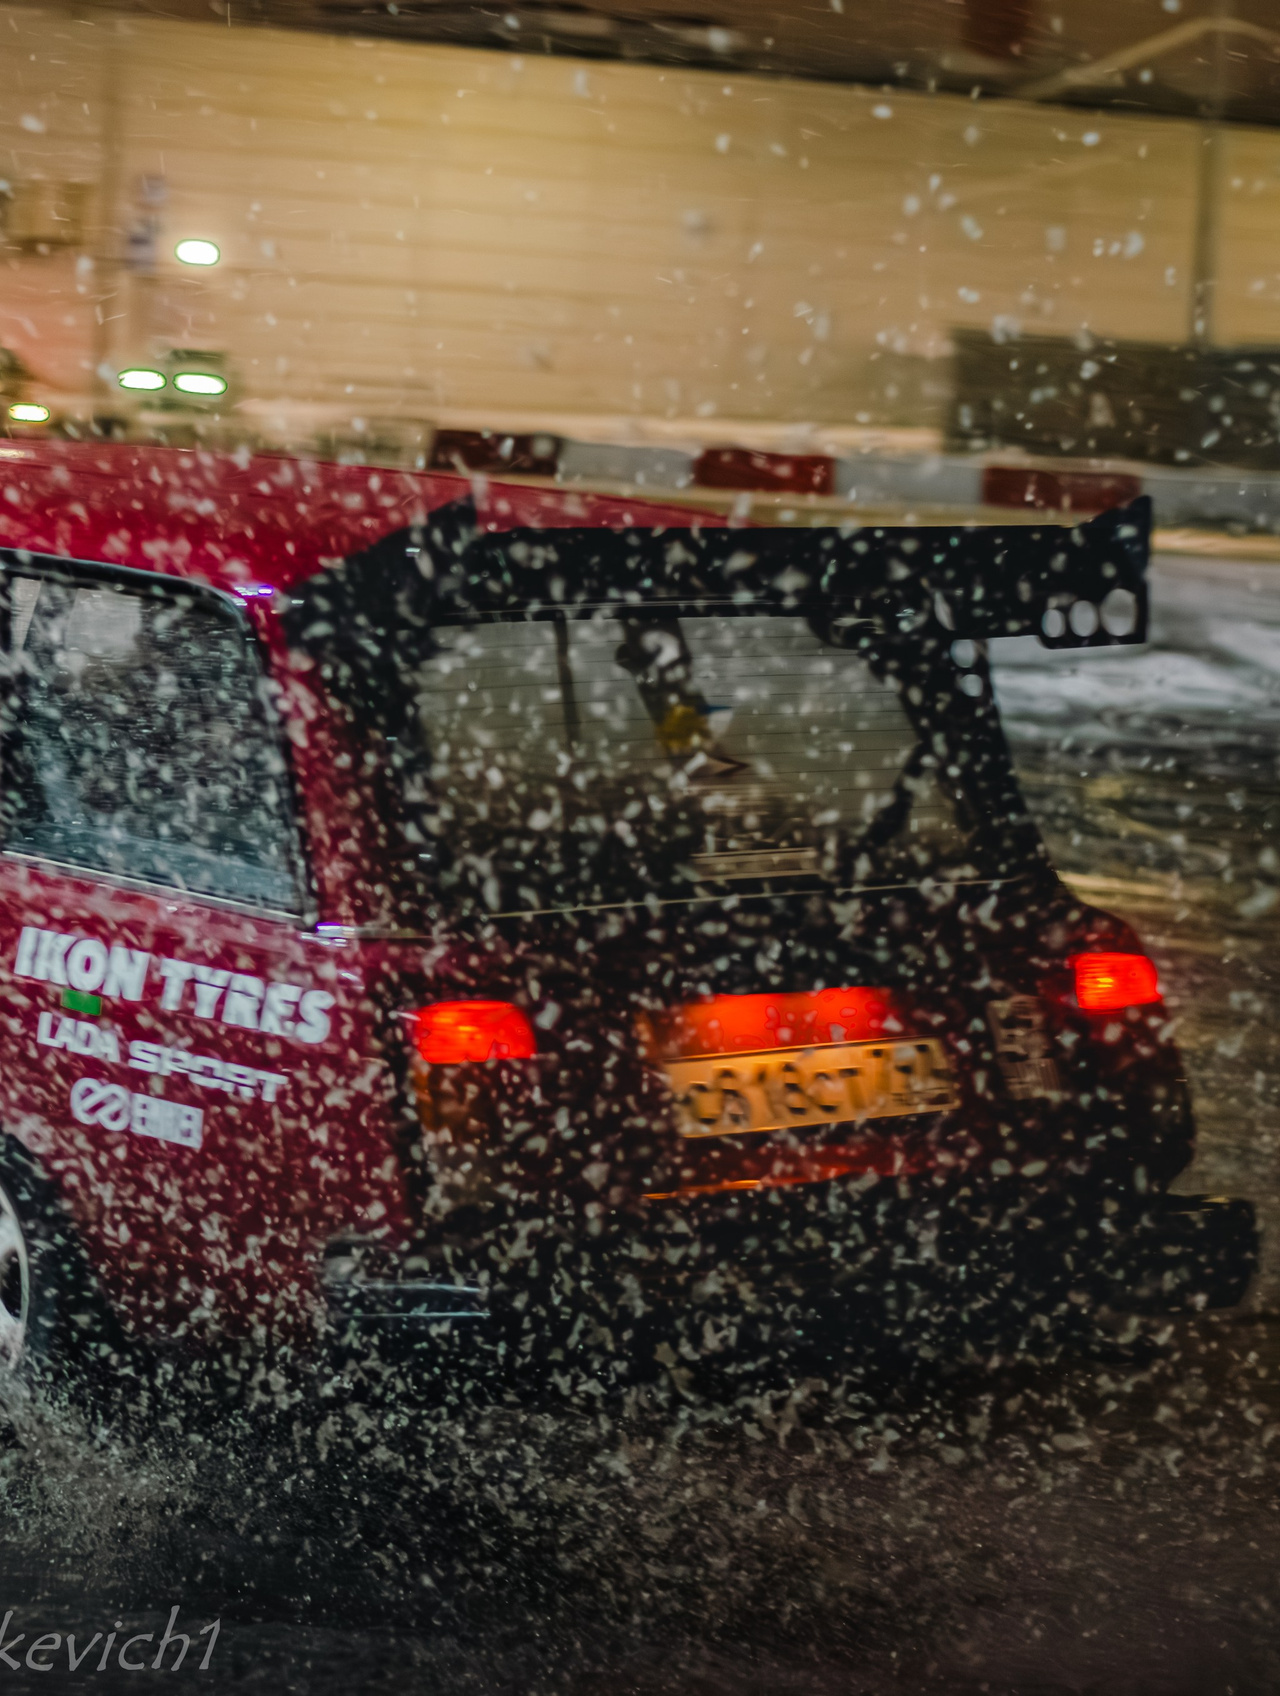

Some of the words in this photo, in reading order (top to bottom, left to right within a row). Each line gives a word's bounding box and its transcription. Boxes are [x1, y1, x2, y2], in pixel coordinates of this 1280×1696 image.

[13, 926, 150, 1002] IKON
[160, 957, 336, 1044] TYRES
[36, 1011, 120, 1063] LADA
[128, 1040, 288, 1103] SPORT
